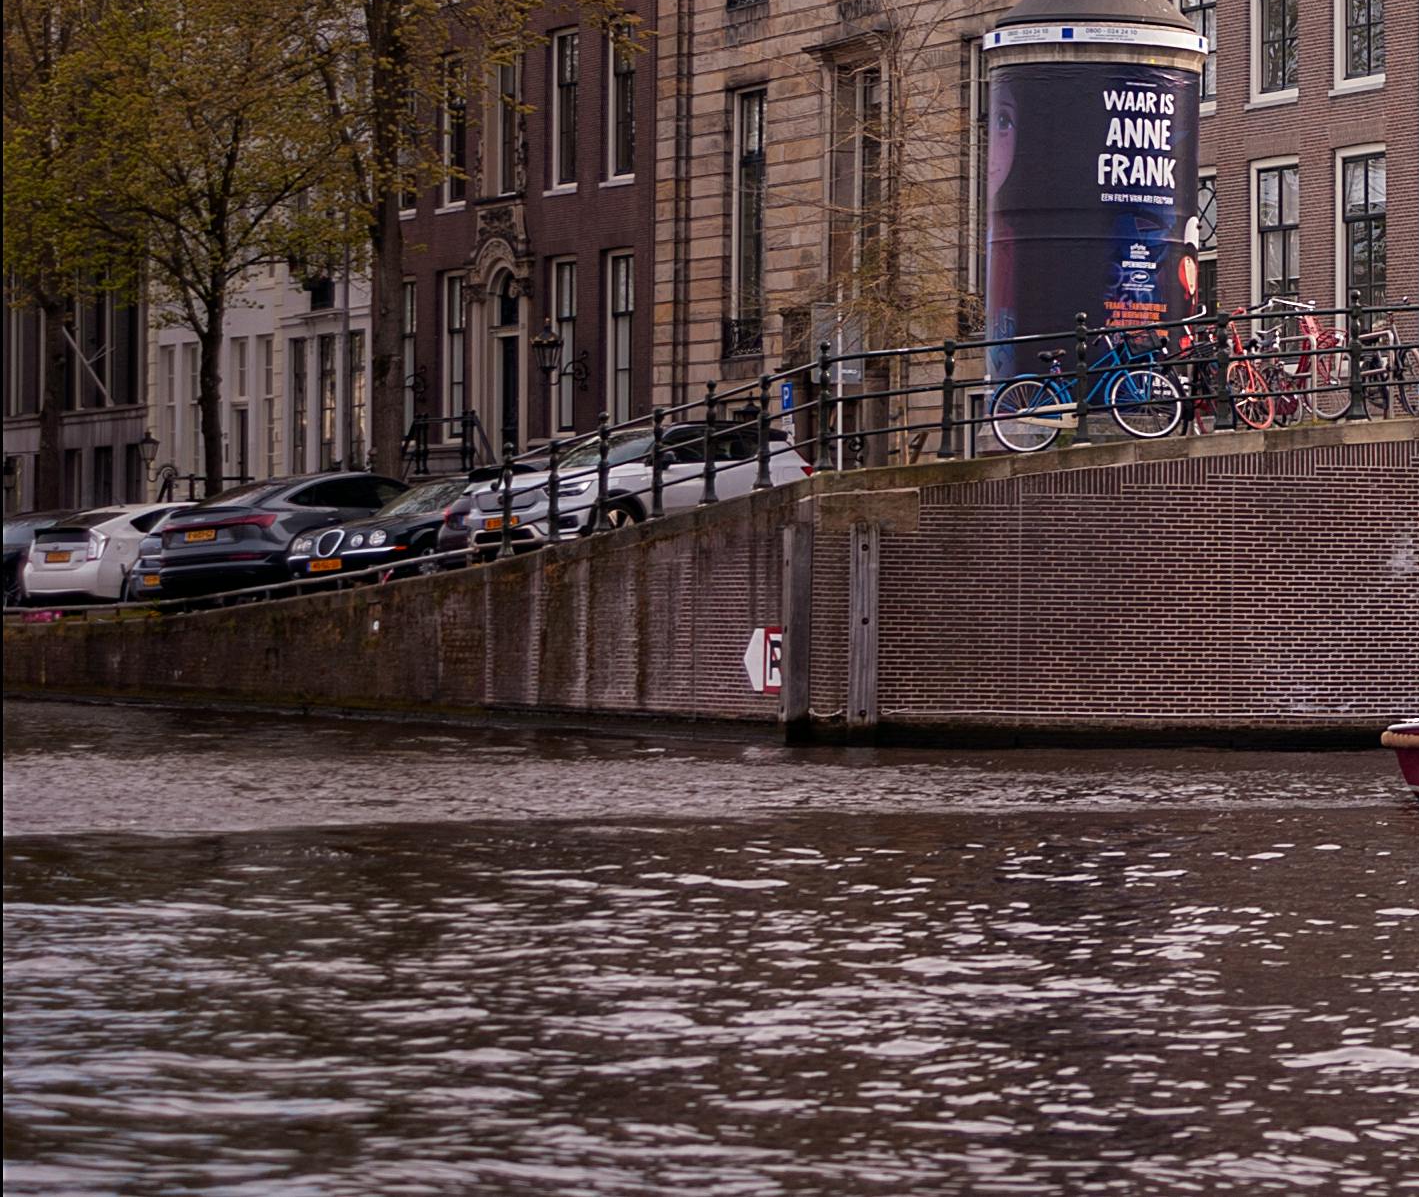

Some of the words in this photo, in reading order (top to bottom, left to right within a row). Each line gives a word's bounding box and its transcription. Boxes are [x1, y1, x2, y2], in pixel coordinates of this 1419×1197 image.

[1103, 90, 1158, 114] WAAR
[1160, 93, 1175, 115] IS
[1106, 117, 1171, 151] ANNE
[1098, 153, 1176, 189] FRANK
[1114, 193, 1129, 202] FILM
[1129, 194, 1142, 203] VAN
